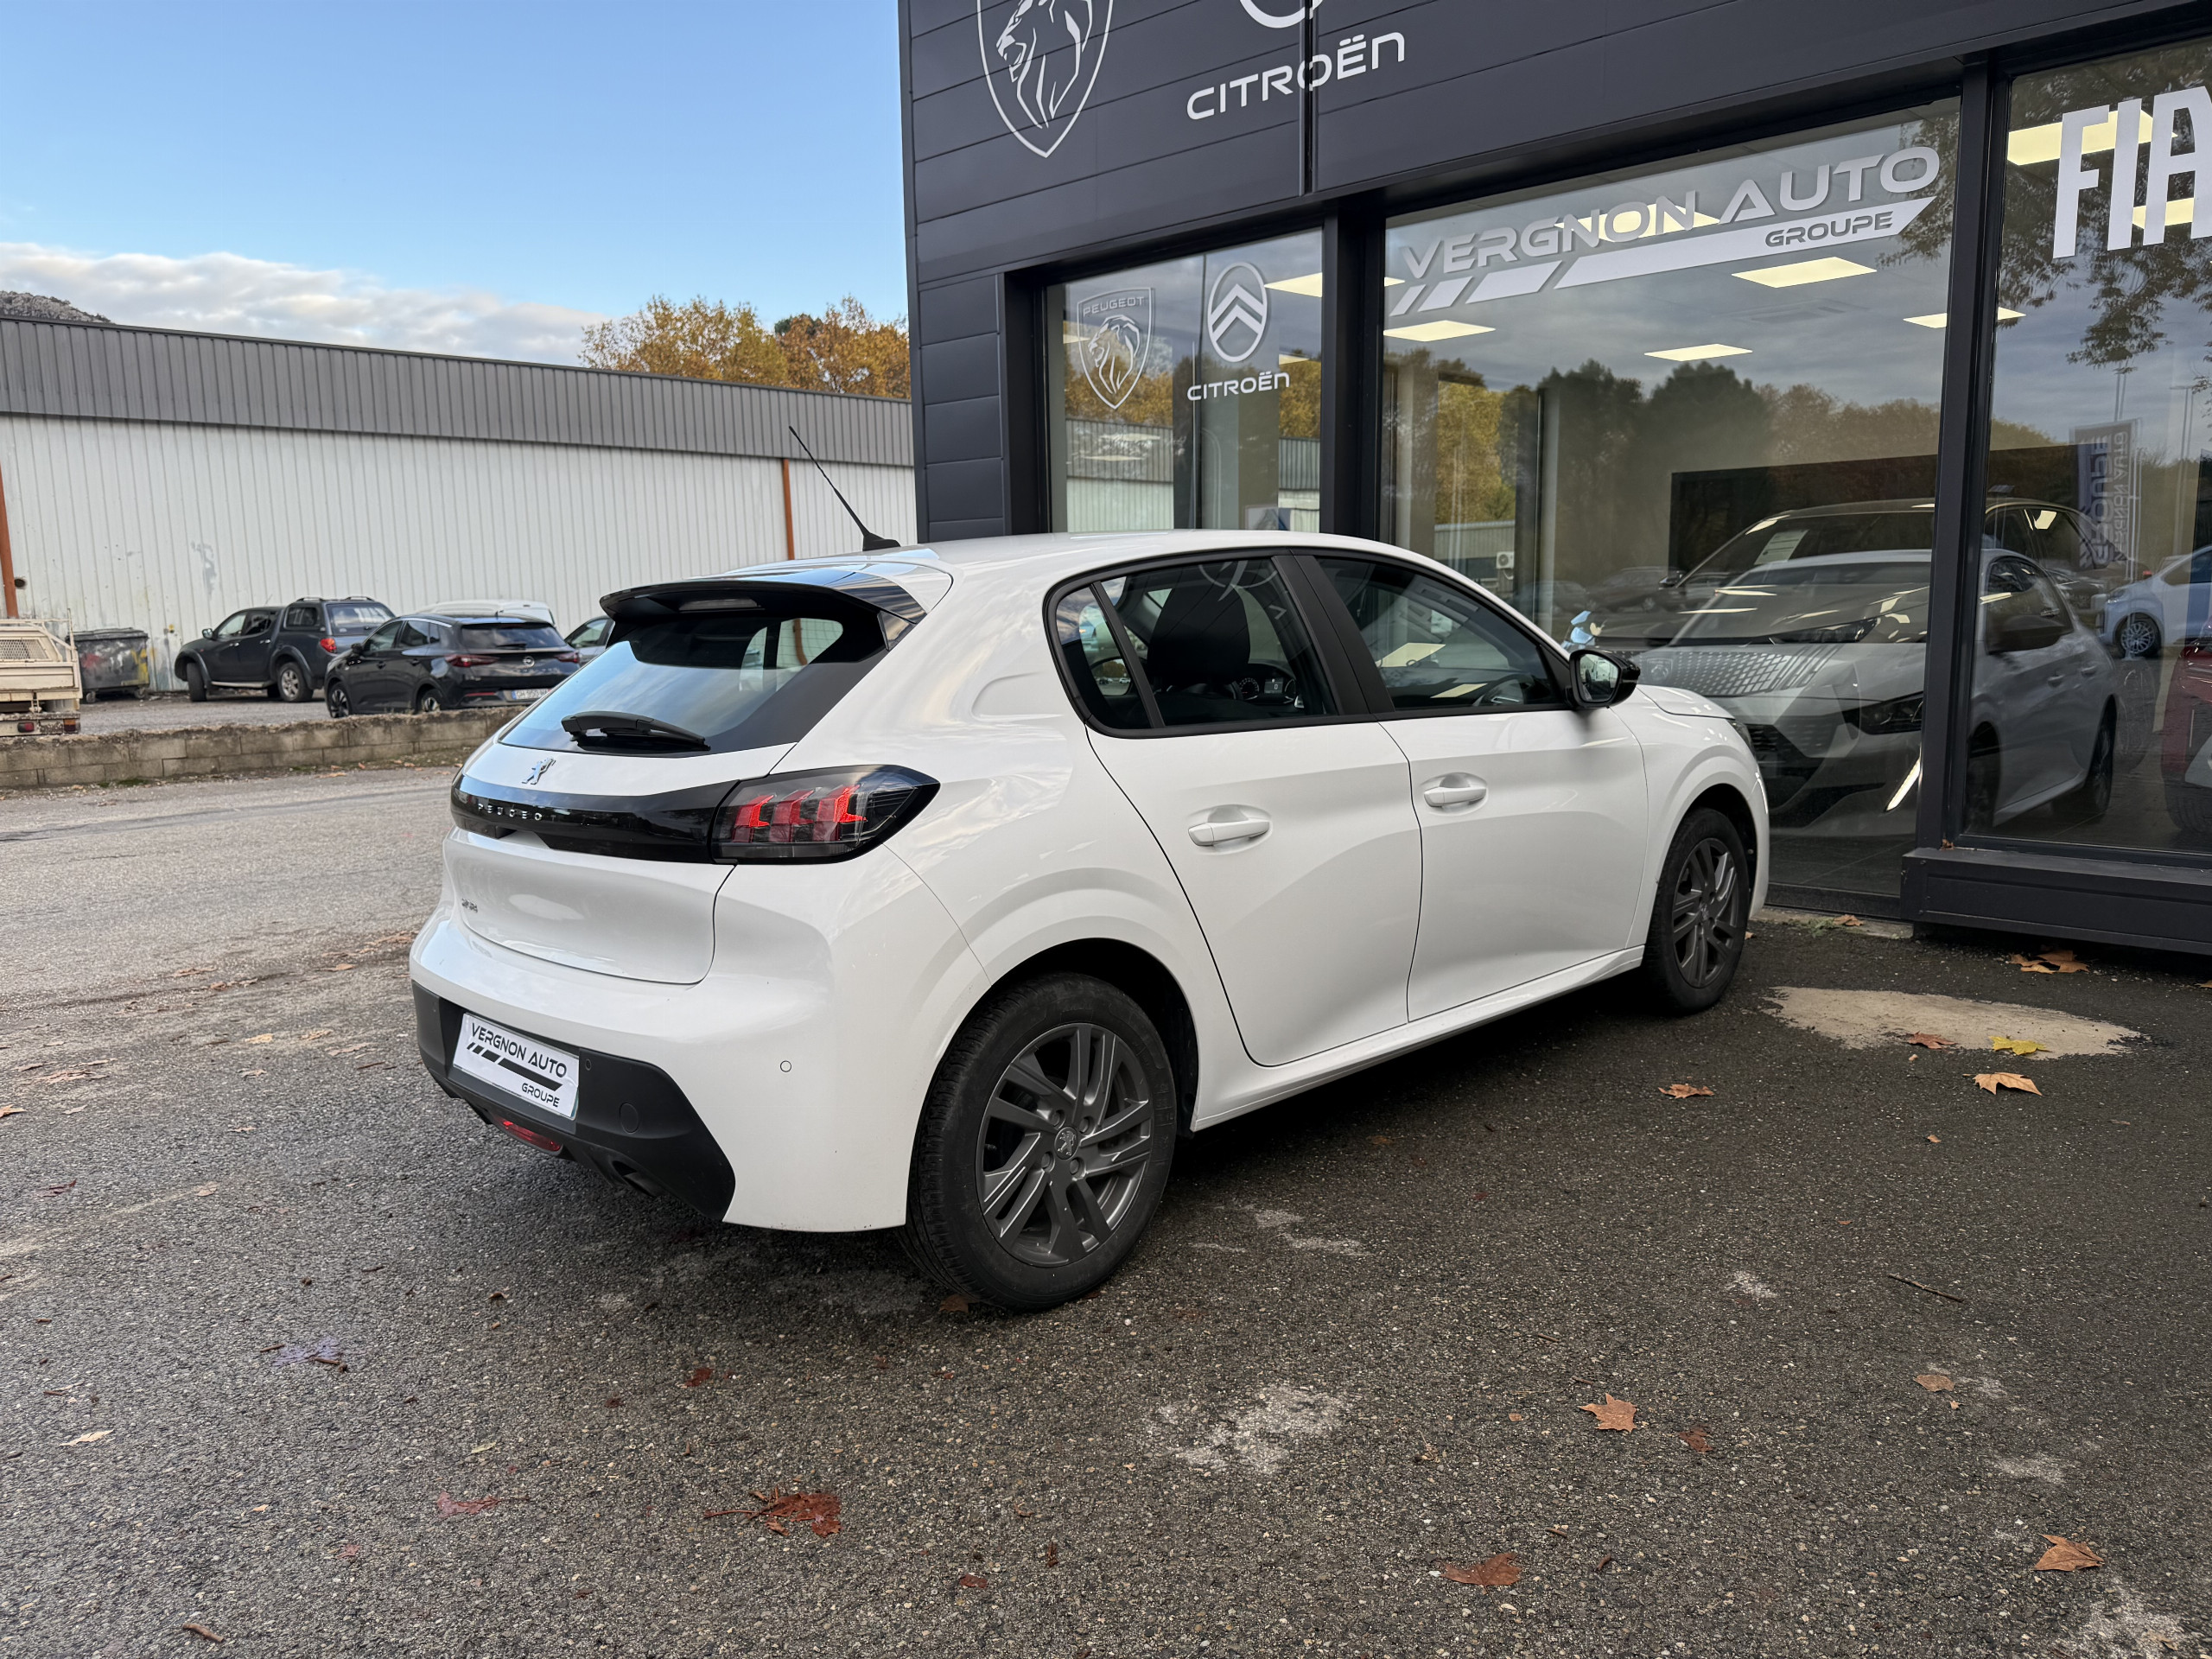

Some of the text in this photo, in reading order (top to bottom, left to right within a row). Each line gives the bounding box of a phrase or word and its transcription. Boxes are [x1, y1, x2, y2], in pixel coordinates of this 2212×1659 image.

[1402, 147, 1941, 279] VERGNON AUTO
[1764, 211, 1894, 247] GROUPE
[1083, 296, 1146, 317] PEUGEOT
[472, 1022, 567, 1078] VERGNON AUTO
[522, 1083, 560, 1108] GROUPE
